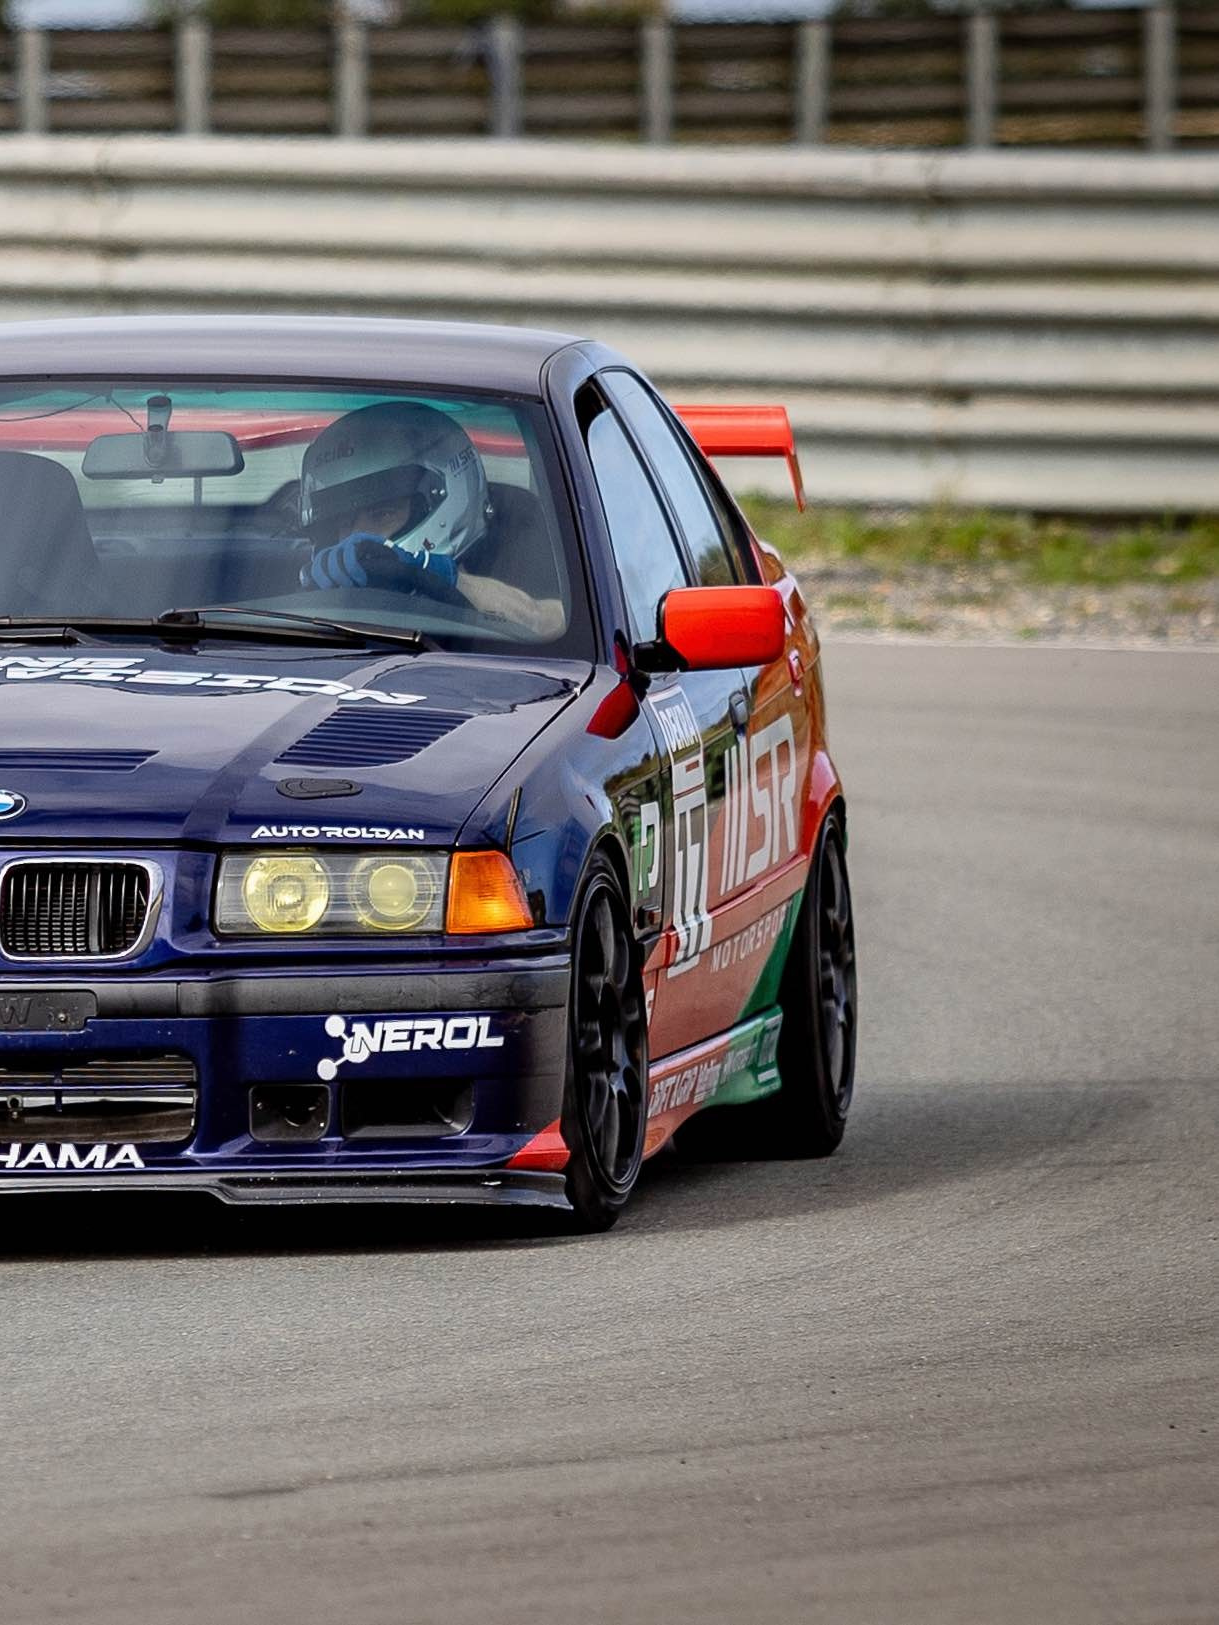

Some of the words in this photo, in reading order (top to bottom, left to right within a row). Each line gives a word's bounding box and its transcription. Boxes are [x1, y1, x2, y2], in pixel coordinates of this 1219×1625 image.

[250, 825, 320, 839] AUTO
[320, 826, 425, 840] ROLDAN
[350, 1016, 504, 1053] NEROL
